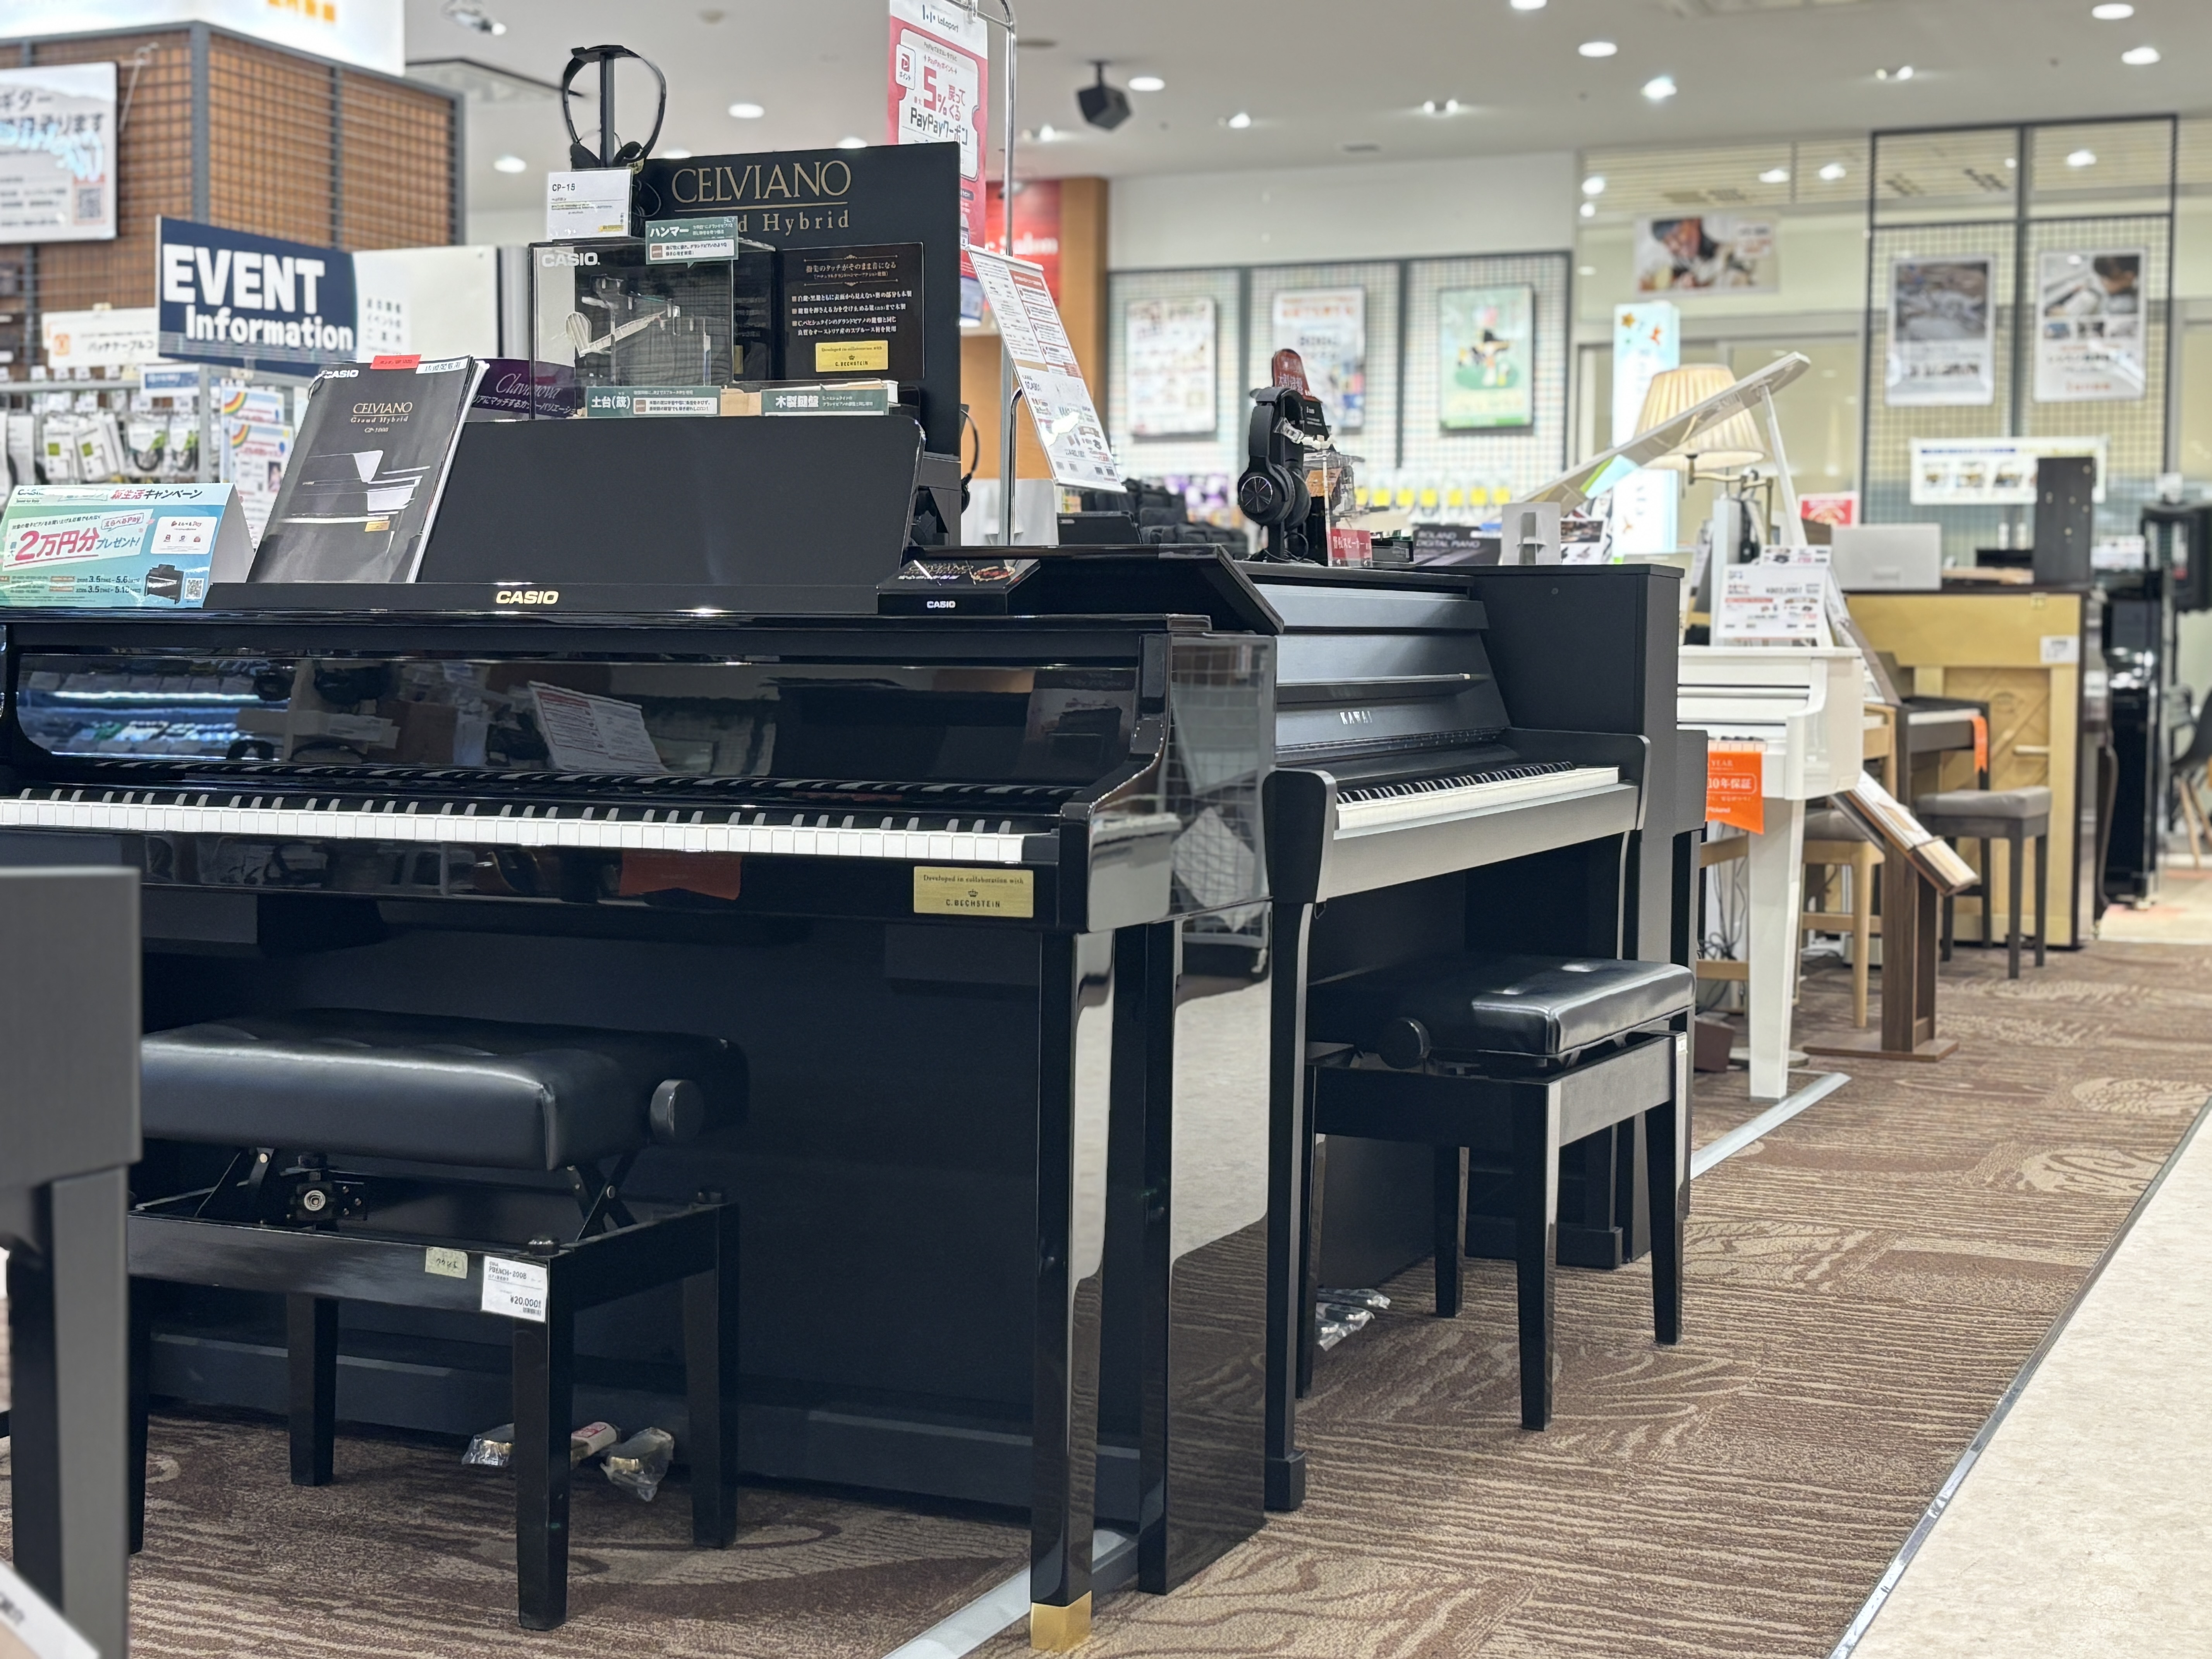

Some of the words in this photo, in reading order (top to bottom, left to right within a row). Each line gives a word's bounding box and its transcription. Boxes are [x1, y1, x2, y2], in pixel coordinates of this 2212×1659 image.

[948, 84, 965, 106] 戻って
[949, 105, 961, 122] くる
[910, 107, 968, 146] PayPayクーポン
[671, 160, 852, 203] CELVIANO
[762, 210, 849, 236] Hybrid
[649, 226, 689, 238] ハンマー
[542, 252, 598, 267] CASIO
[163, 243, 325, 314] EVENT
[185, 304, 354, 351] Information
[323, 370, 359, 379] CASIO
[353, 402, 413, 414] CELVIANO
[379, 416, 409, 424] Hybrid
[110, 489, 203, 500] 新生活キャンペーン
[15, 527, 100, 561] 2万円分
[96, 537, 141, 550] プレゼント!
[496, 590, 559, 606] CASIO
[926, 600, 956, 608] CASIO
[1340, 711, 1372, 725] KAWAI
[923, 874, 955, 883] Developed
[965, 875, 1007, 883] collaboration
[946, 899, 1000, 908] C.BECHSTEIN
